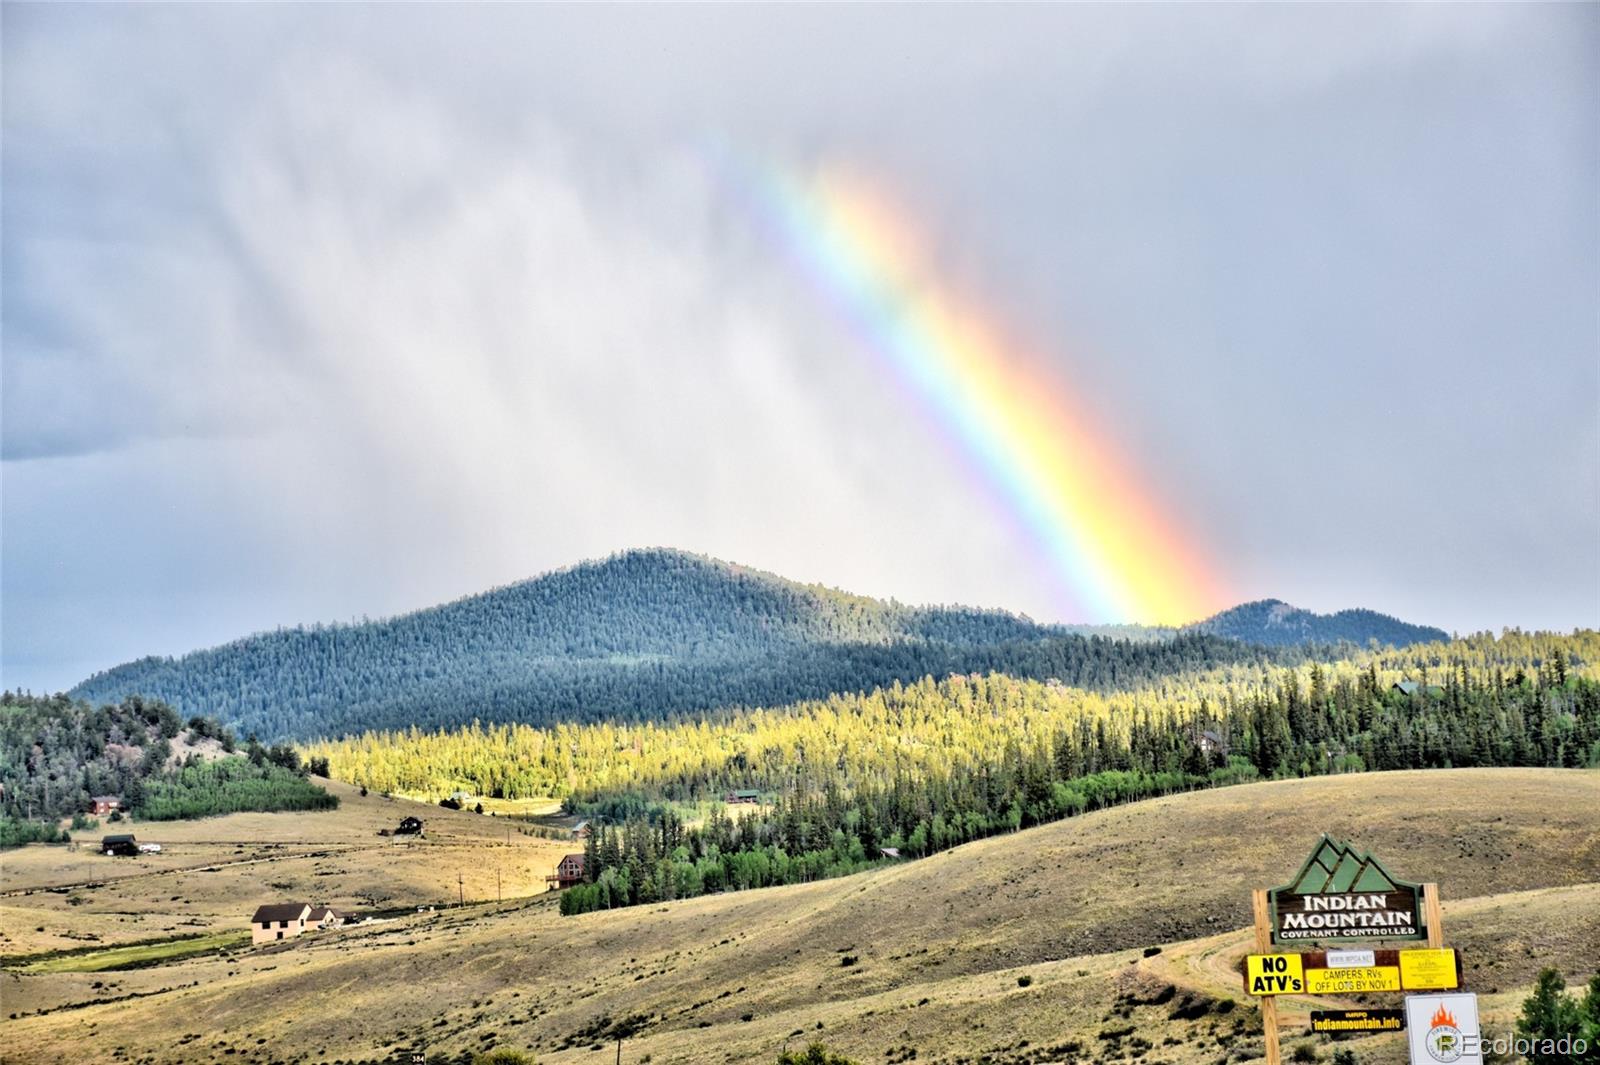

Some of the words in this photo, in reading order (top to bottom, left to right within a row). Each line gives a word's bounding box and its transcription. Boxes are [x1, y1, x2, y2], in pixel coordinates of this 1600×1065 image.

[1303, 895, 1387, 911] INDIAN
[1282, 911, 1412, 929] MOUNTAIN
[1281, 929, 1339, 939] COVENANT
[1342, 927, 1416, 937] CONTROLLED
[1262, 957, 1287, 973] NO
[1367, 969, 1382, 979] RVs
[1253, 975, 1302, 992] ATV's
[1315, 982, 1330, 992] OFF
[1333, 981, 1354, 991] LOTS
[1356, 981, 1367, 990] BY
[1369, 979, 1387, 989] NOV
[1314, 1017, 1400, 1031] indianmountain.info
